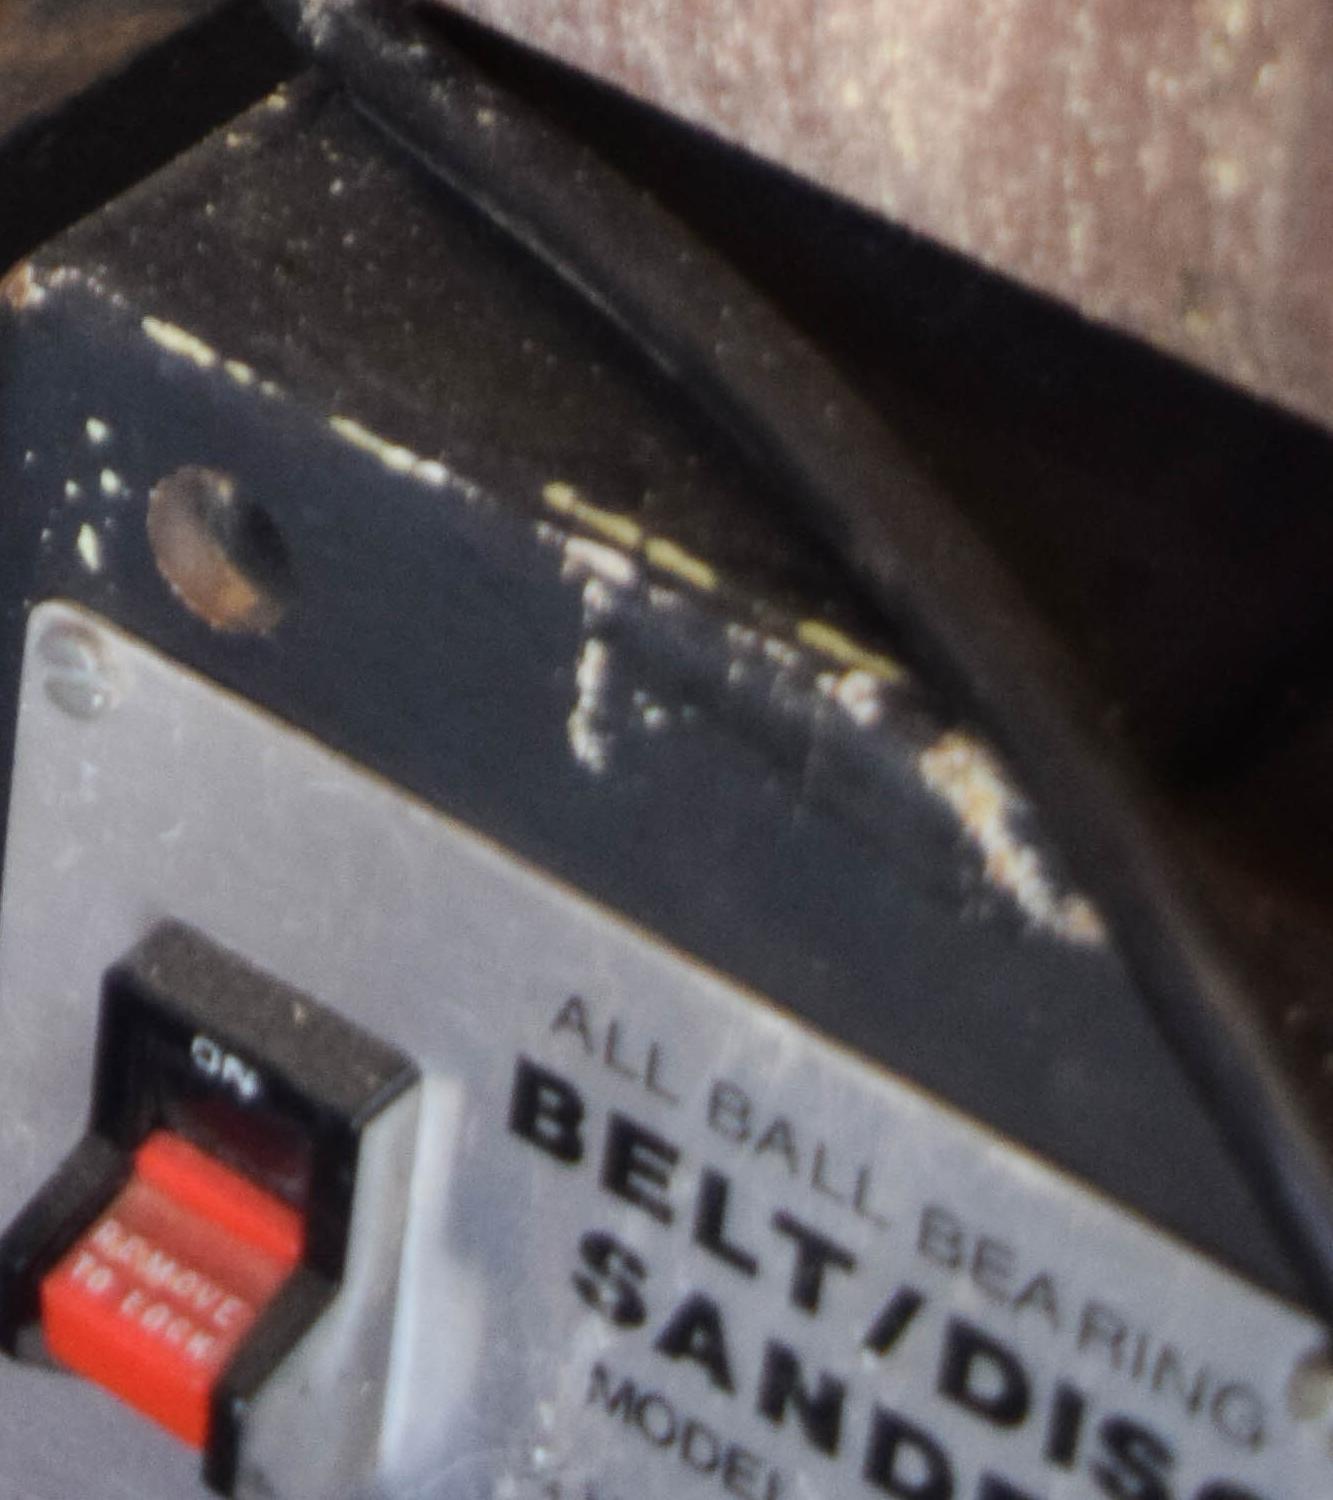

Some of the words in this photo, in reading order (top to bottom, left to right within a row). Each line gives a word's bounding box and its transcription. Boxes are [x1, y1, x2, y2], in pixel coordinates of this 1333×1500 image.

[190, 1035, 260, 1098] ON
[550, 995, 681, 1107] ALL
[706, 1075, 890, 1230] BALL
[916, 1202, 1267, 1454] BEARING
[507, 1052, 1271, 1500] BELT/DIS
[571, 1229, 1051, 1500] SAND
